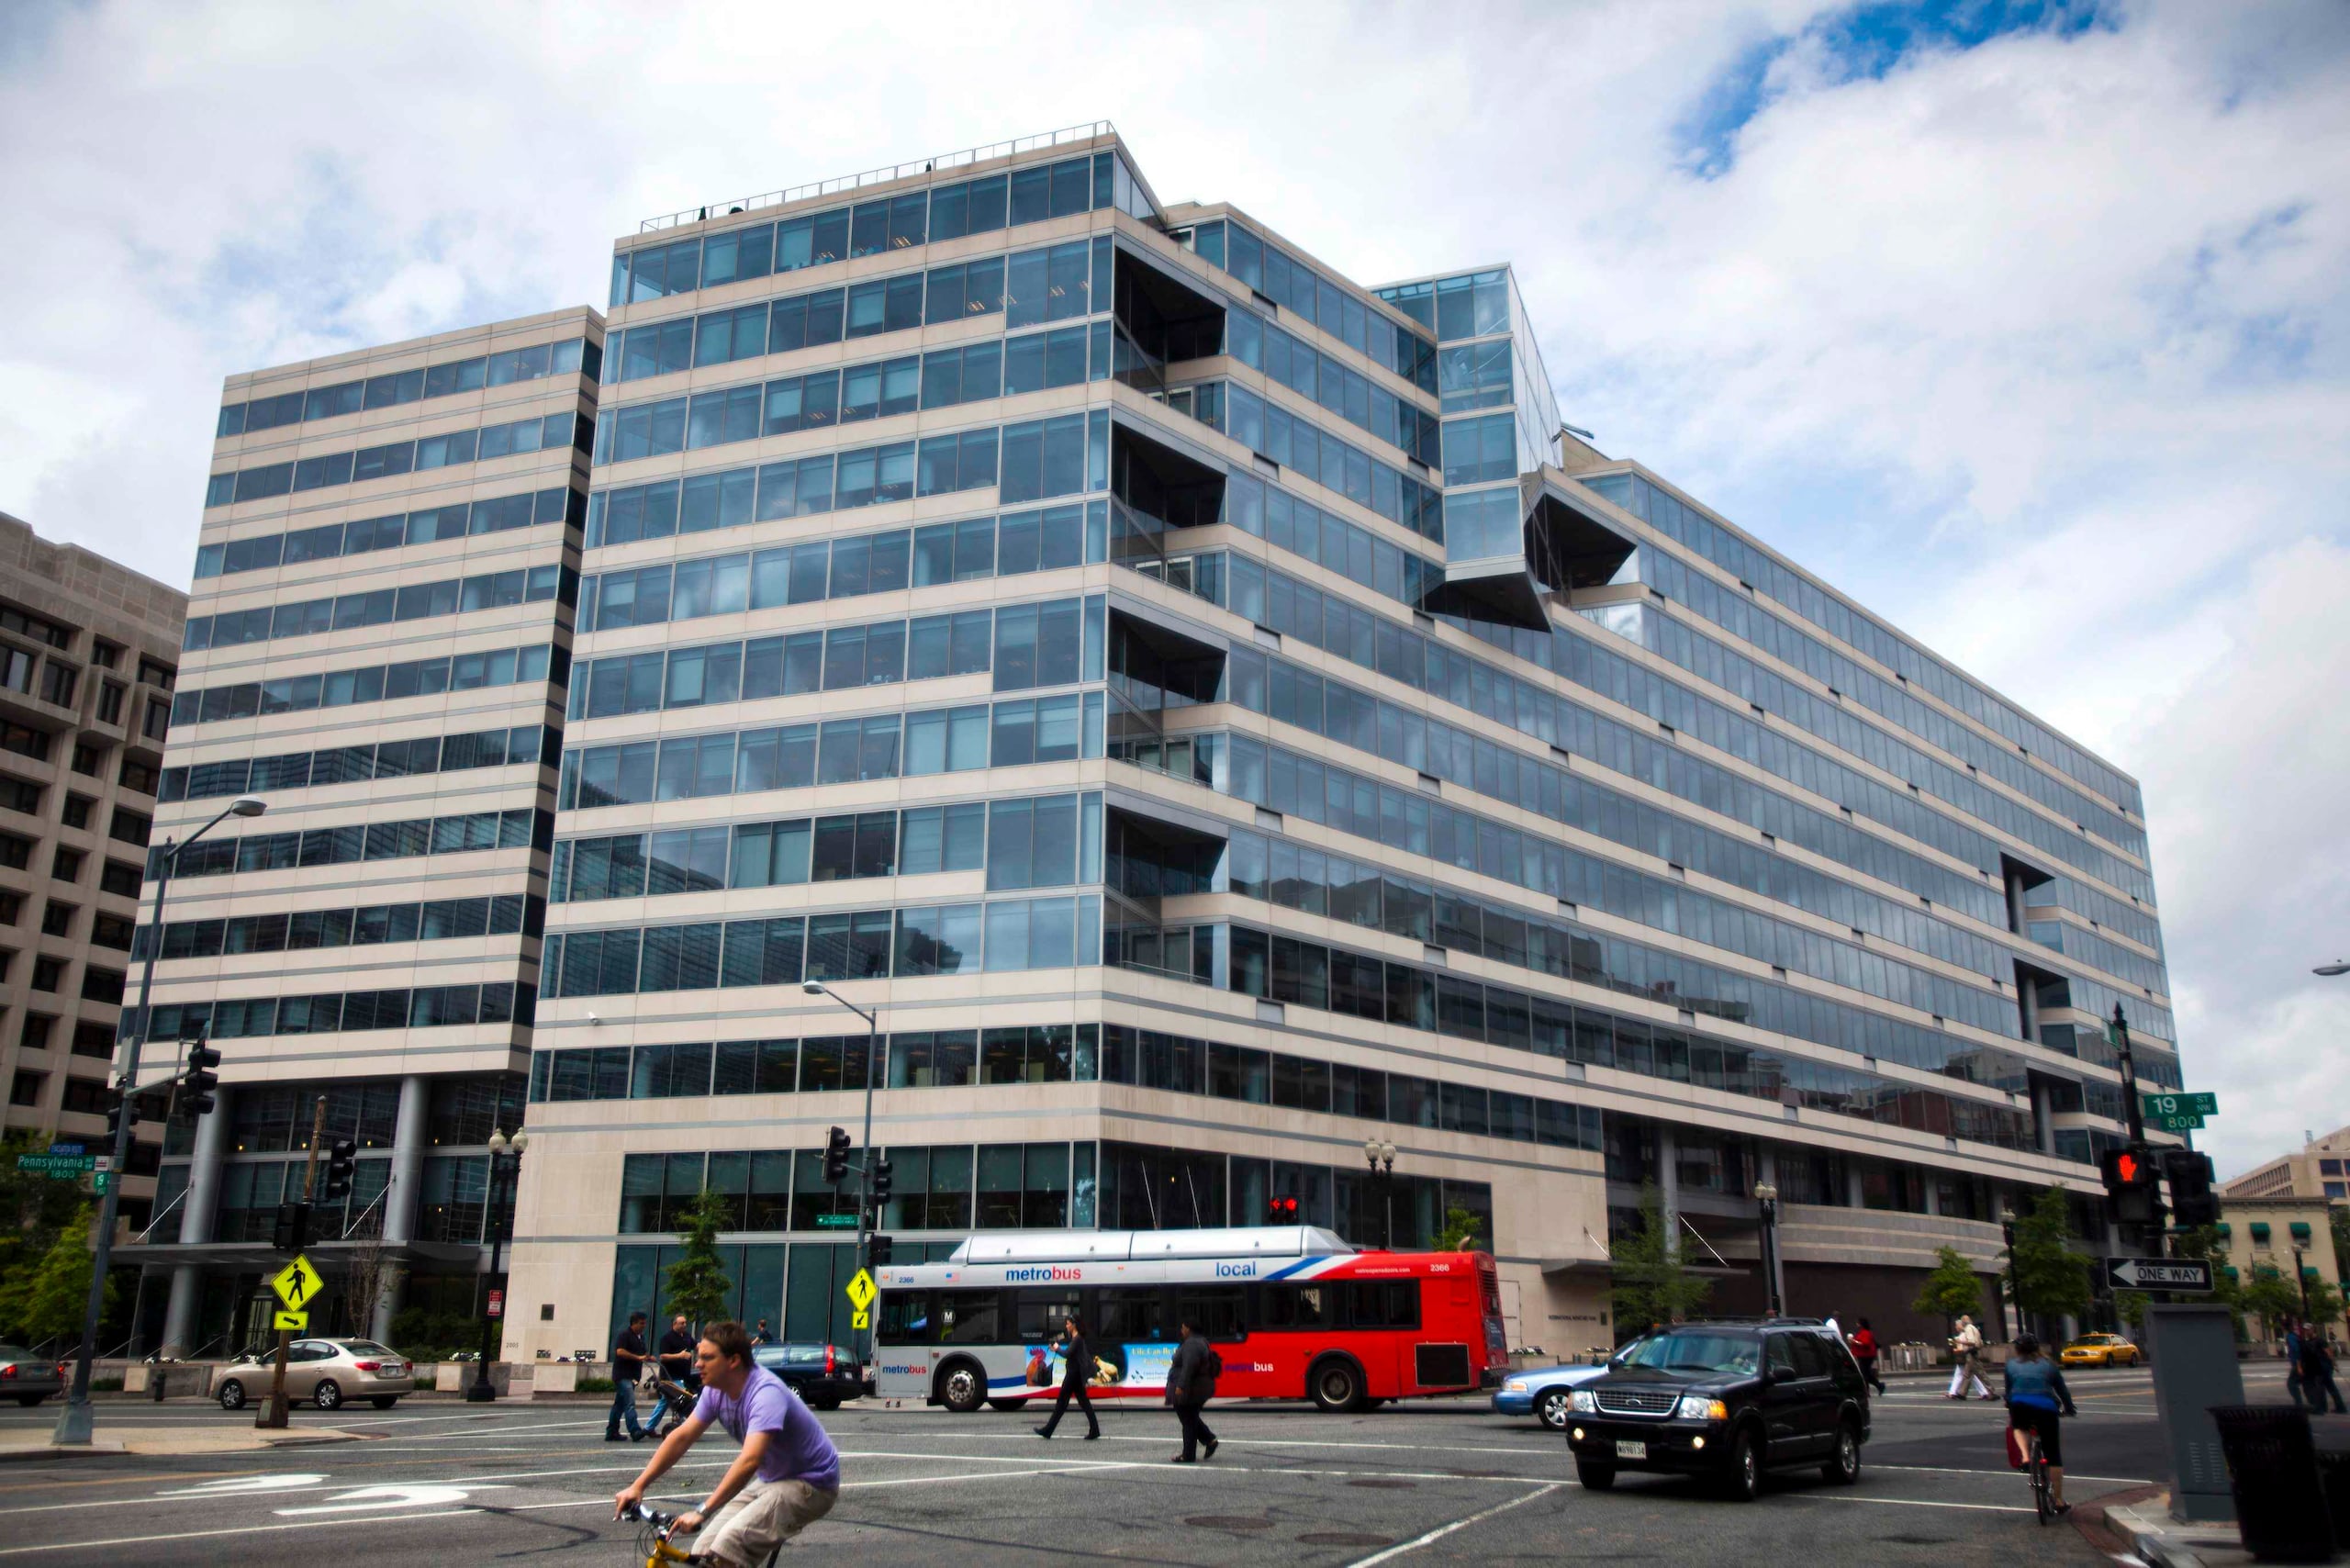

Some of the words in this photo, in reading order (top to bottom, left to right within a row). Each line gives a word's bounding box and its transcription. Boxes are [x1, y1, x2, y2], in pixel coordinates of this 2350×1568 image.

[2153, 1096, 2177, 1114] 19
[2196, 1095, 2209, 1103] ST
[2197, 1103, 2211, 1112] NW
[2168, 1115, 2198, 1128] 800
[17, 1156, 84, 1170] Pennsylvania
[50, 1170, 75, 1179] 1800
[1006, 1266, 1081, 1281] metrobus
[1216, 1260, 1256, 1277] local
[2138, 1267, 2165, 1280] ONE
[2171, 1268, 2199, 1282] WAY
[882, 1364, 926, 1374] metrobus
